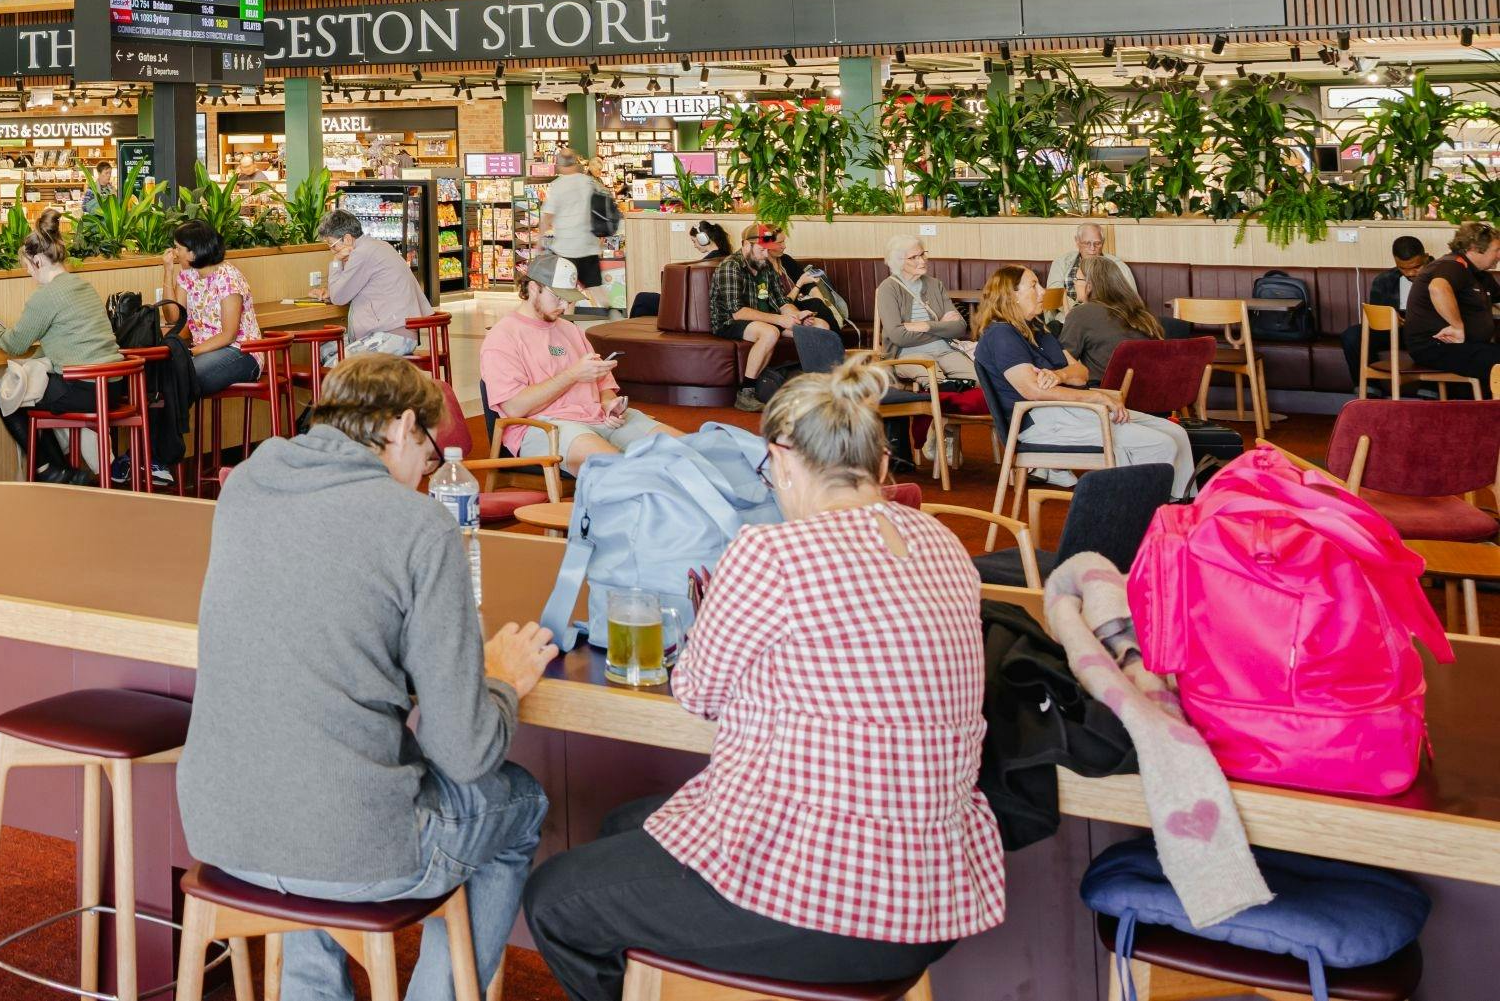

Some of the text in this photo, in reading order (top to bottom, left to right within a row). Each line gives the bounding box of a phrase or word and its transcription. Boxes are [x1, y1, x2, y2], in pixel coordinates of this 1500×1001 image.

[152, 1, 174, 12] Brisbane
[152, 14, 170, 26] Sydney
[243, 21, 262, 31] DELAYED
[118, 26, 151, 36] CONNECTION
[151, 28, 171, 37] FLIGHTS
[138, 52, 168, 63] Gates 1-4
[153, 67, 179, 77] Departures
[626, 100, 658, 114] PAY
[20, 124, 31, 138] &
[33, 122, 112, 137] SOUVENIRS
